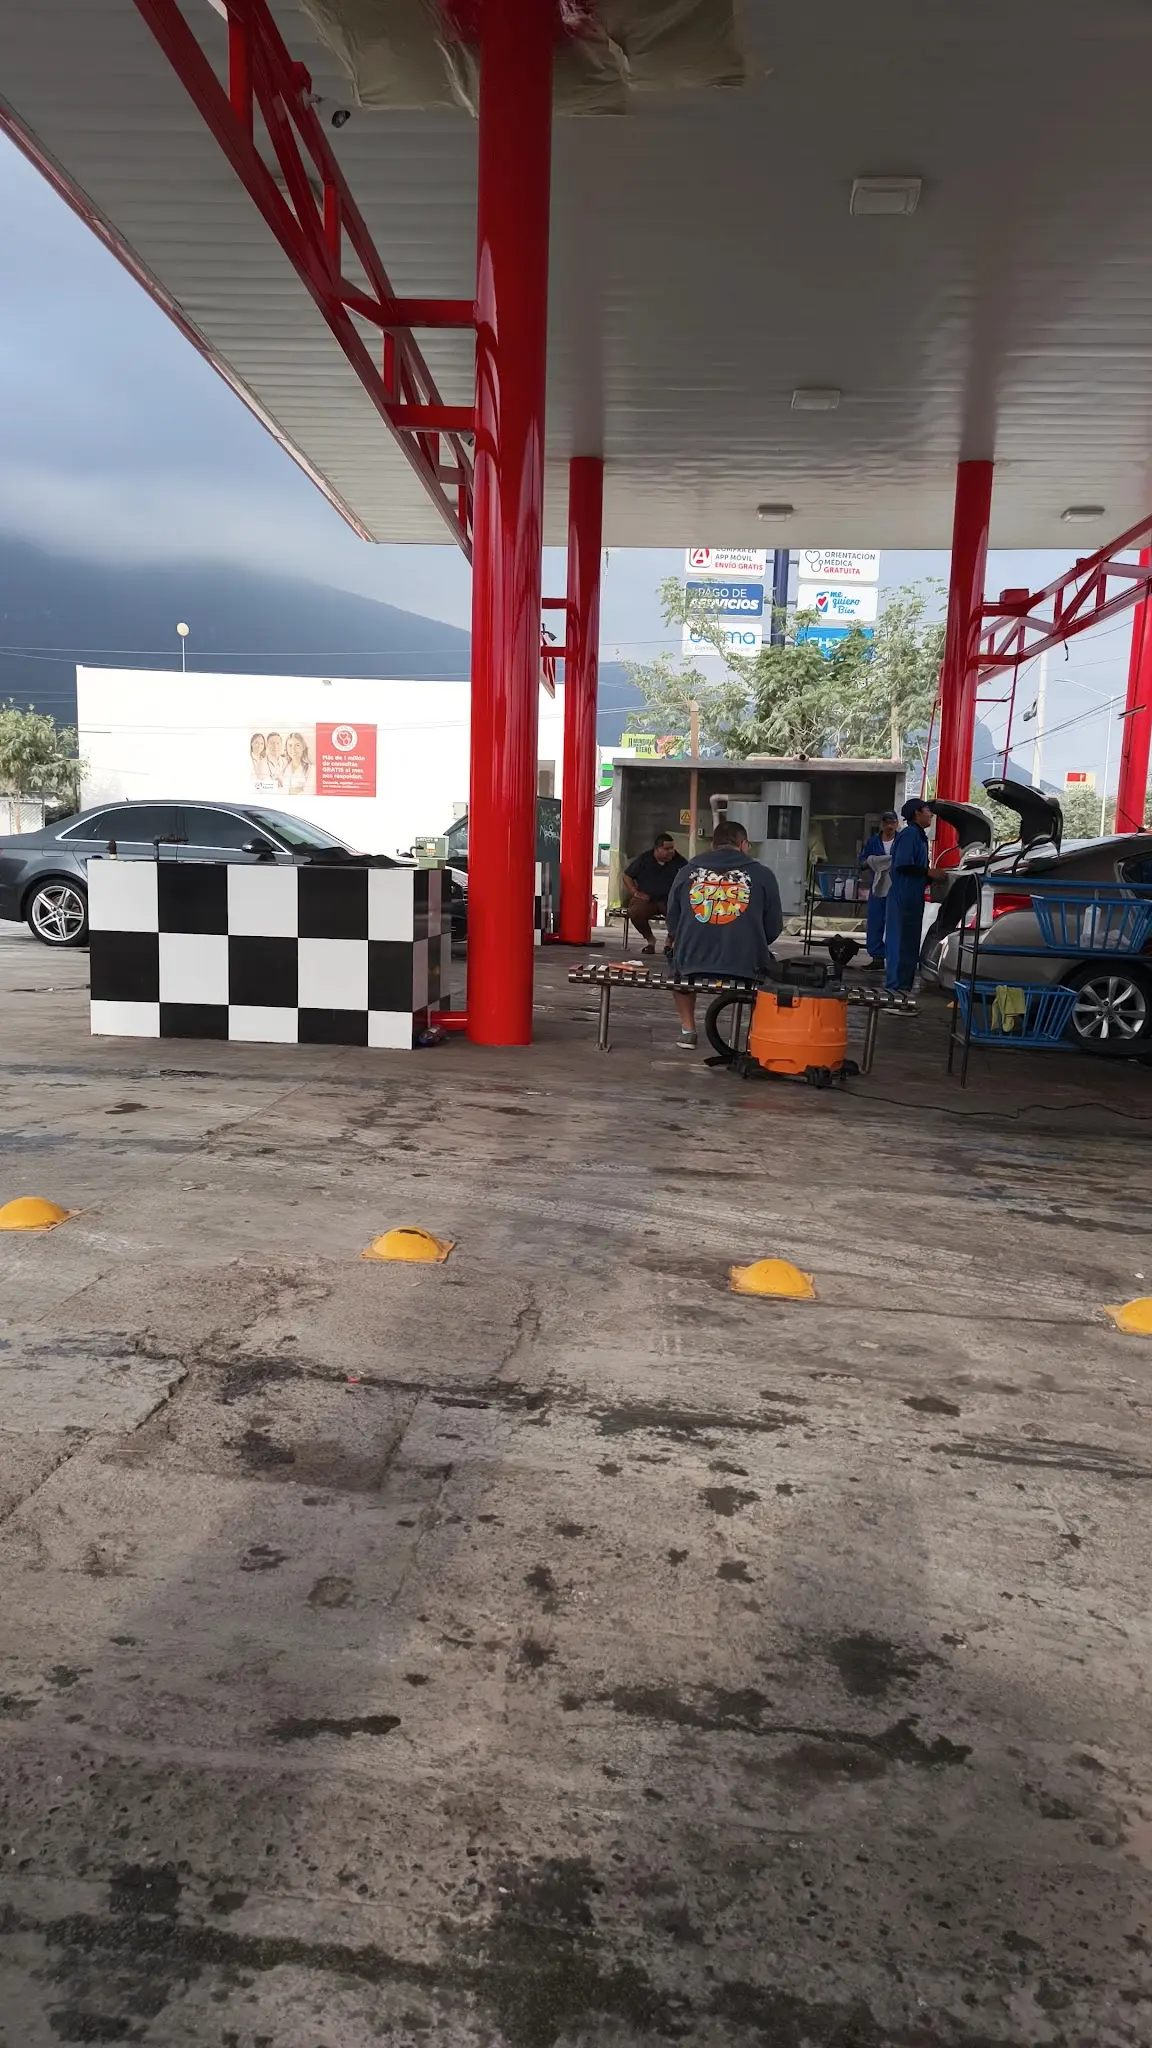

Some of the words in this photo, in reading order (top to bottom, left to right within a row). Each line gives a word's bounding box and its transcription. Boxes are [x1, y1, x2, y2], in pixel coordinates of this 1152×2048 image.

[730, 554, 753, 562] MÓVIL
[825, 550, 876, 560] ORIENTACIÓN
[715, 561, 737, 569] ENVÍO
[738, 563, 763, 571] GRATIS
[824, 558, 853, 567] MÉDICA
[823, 566, 861, 575] GRATUITA
[732, 588, 747, 598] DE
[832, 596, 861, 609] quiero
[838, 605, 856, 614] Bien
[689, 883, 751, 905] SPACE
[694, 899, 741, 923] JAM
